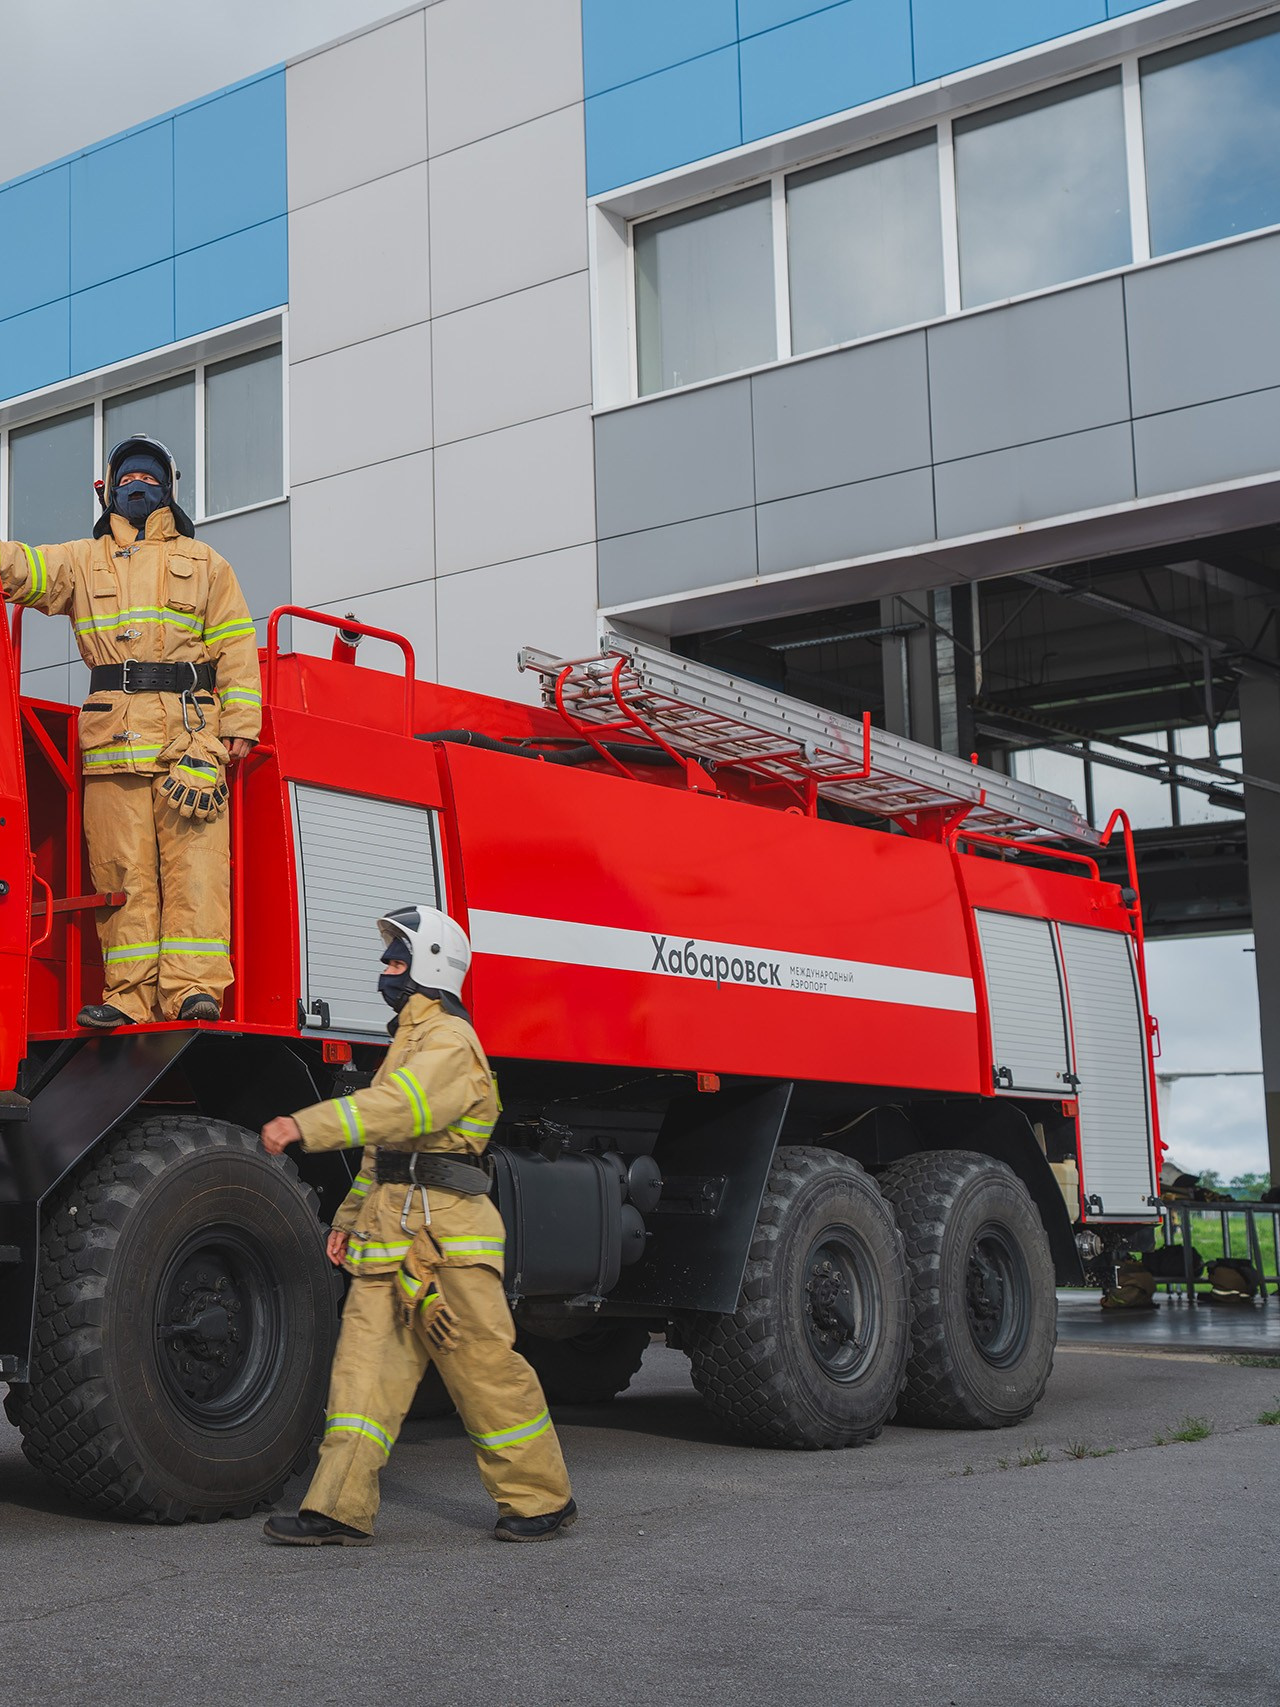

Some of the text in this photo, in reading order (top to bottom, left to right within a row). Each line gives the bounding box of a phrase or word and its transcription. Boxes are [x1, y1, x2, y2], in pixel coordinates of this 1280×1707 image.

[650, 935, 782, 990] Хабаровск
[789, 965, 854, 983] МЕЖДУНАРОДНЫЙ
[790, 979, 827, 992] АЭРОПОРТ
